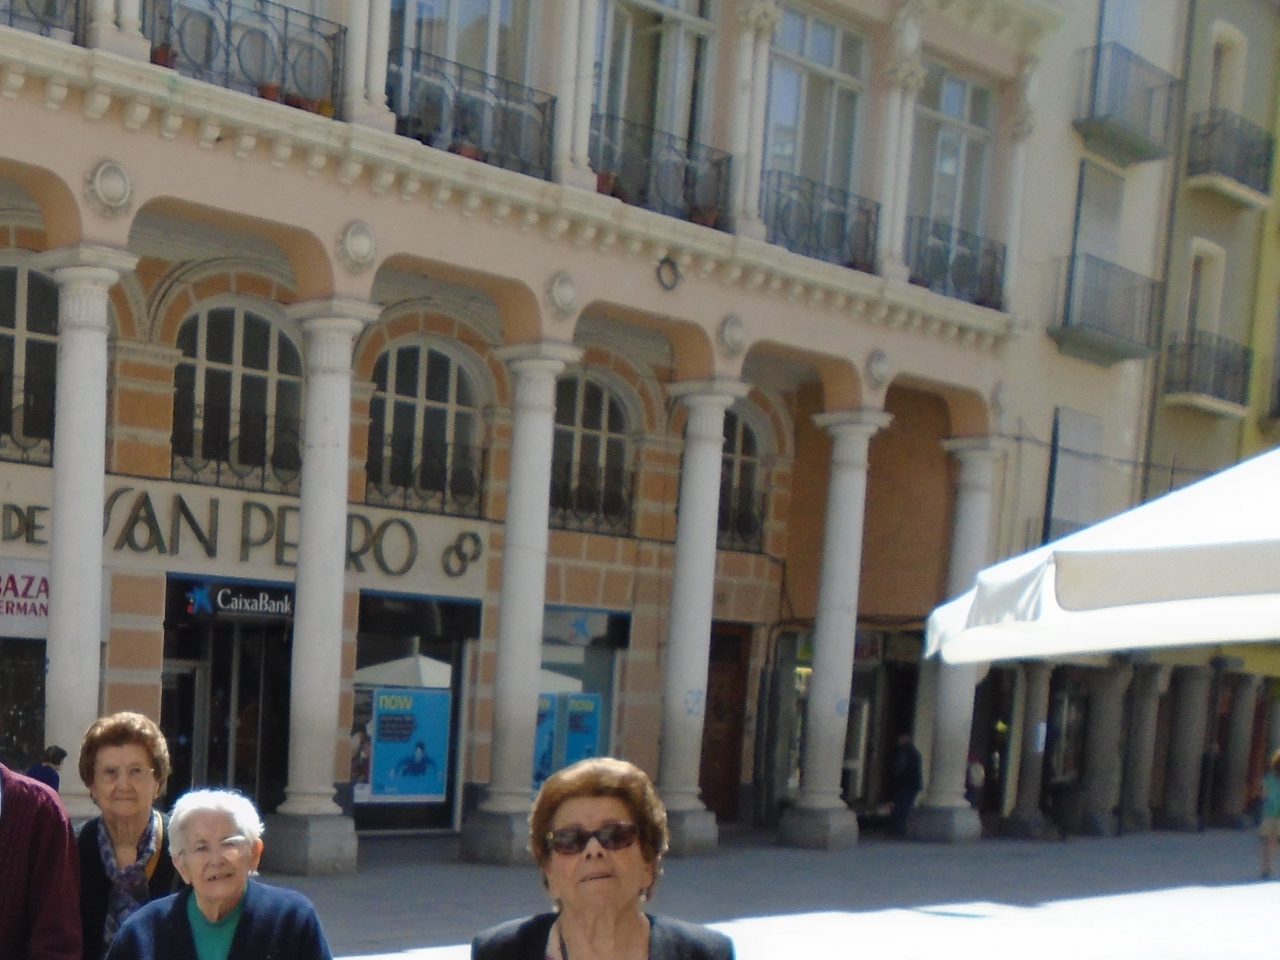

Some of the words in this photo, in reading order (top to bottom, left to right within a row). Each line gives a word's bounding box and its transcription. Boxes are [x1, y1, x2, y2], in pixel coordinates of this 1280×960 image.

[1, 503, 50, 545] DE
[240, 500, 418, 577] PERO
[217, 588, 291, 614] CaixaBank
